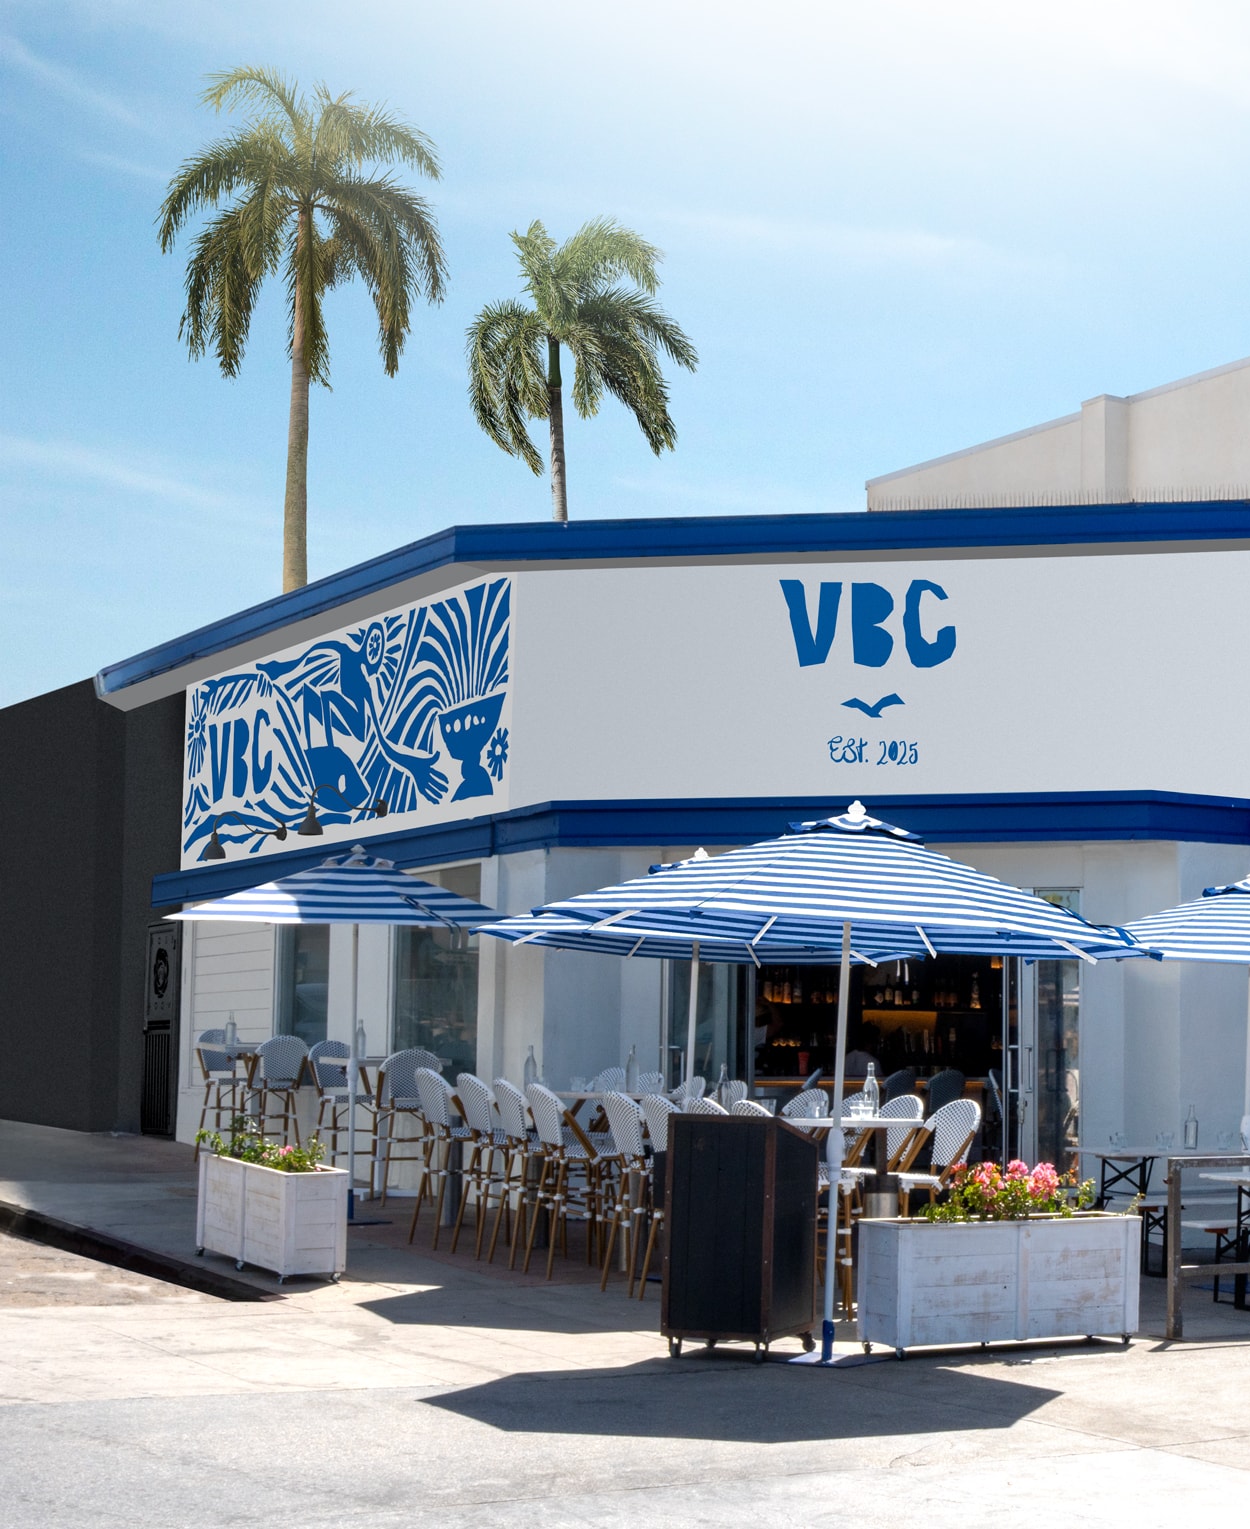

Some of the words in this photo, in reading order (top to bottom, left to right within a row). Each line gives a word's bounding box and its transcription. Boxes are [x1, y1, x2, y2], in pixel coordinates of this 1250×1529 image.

[779, 579, 957, 669] VBC
[208, 709, 273, 804] VBC
[876, 740, 919, 766] 2025
